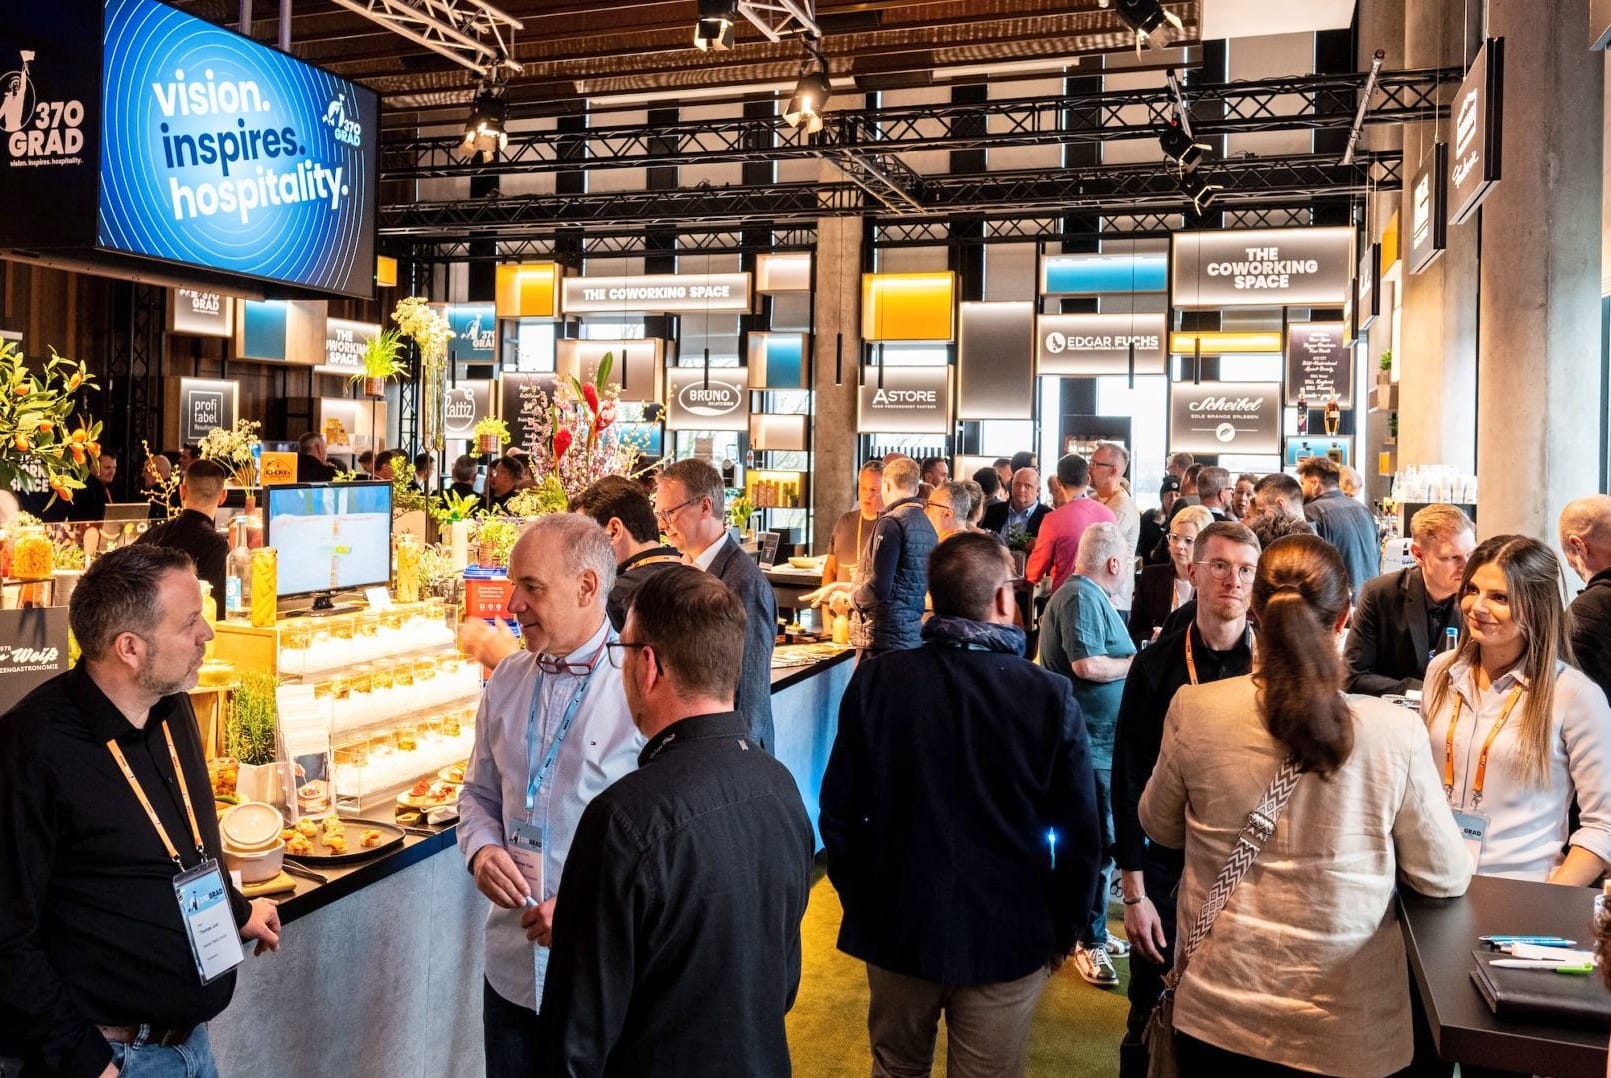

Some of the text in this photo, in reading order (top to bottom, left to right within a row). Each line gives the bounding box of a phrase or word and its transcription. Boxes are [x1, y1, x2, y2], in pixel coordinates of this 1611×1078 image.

[152, 69, 270, 117] vision.
[36, 99, 84, 129] 370
[344, 119, 361, 135] 370
[8, 126, 84, 157] GRAD
[334, 127, 361, 147] GRAD
[160, 118, 306, 177] inspires.
[168, 158, 349, 225] hospitality.
[1245, 247, 1279, 261] THE
[1207, 259, 1319, 276] COWORKING
[1234, 274, 1290, 289] SPACE
[583, 285, 730, 300] THE COWORKING SPACE
[192, 297, 220, 311] GRAD
[336, 328, 354, 342] THE
[1067, 335, 1159, 347] EDGAR FUCHS
[329, 351, 359, 366] SPACE
[689, 389, 730, 402] BRUNO
[871, 388, 937, 404] ASTORE
[1188, 396, 1264, 412] Scheibel
[1463, 828, 1482, 837] GRAD
